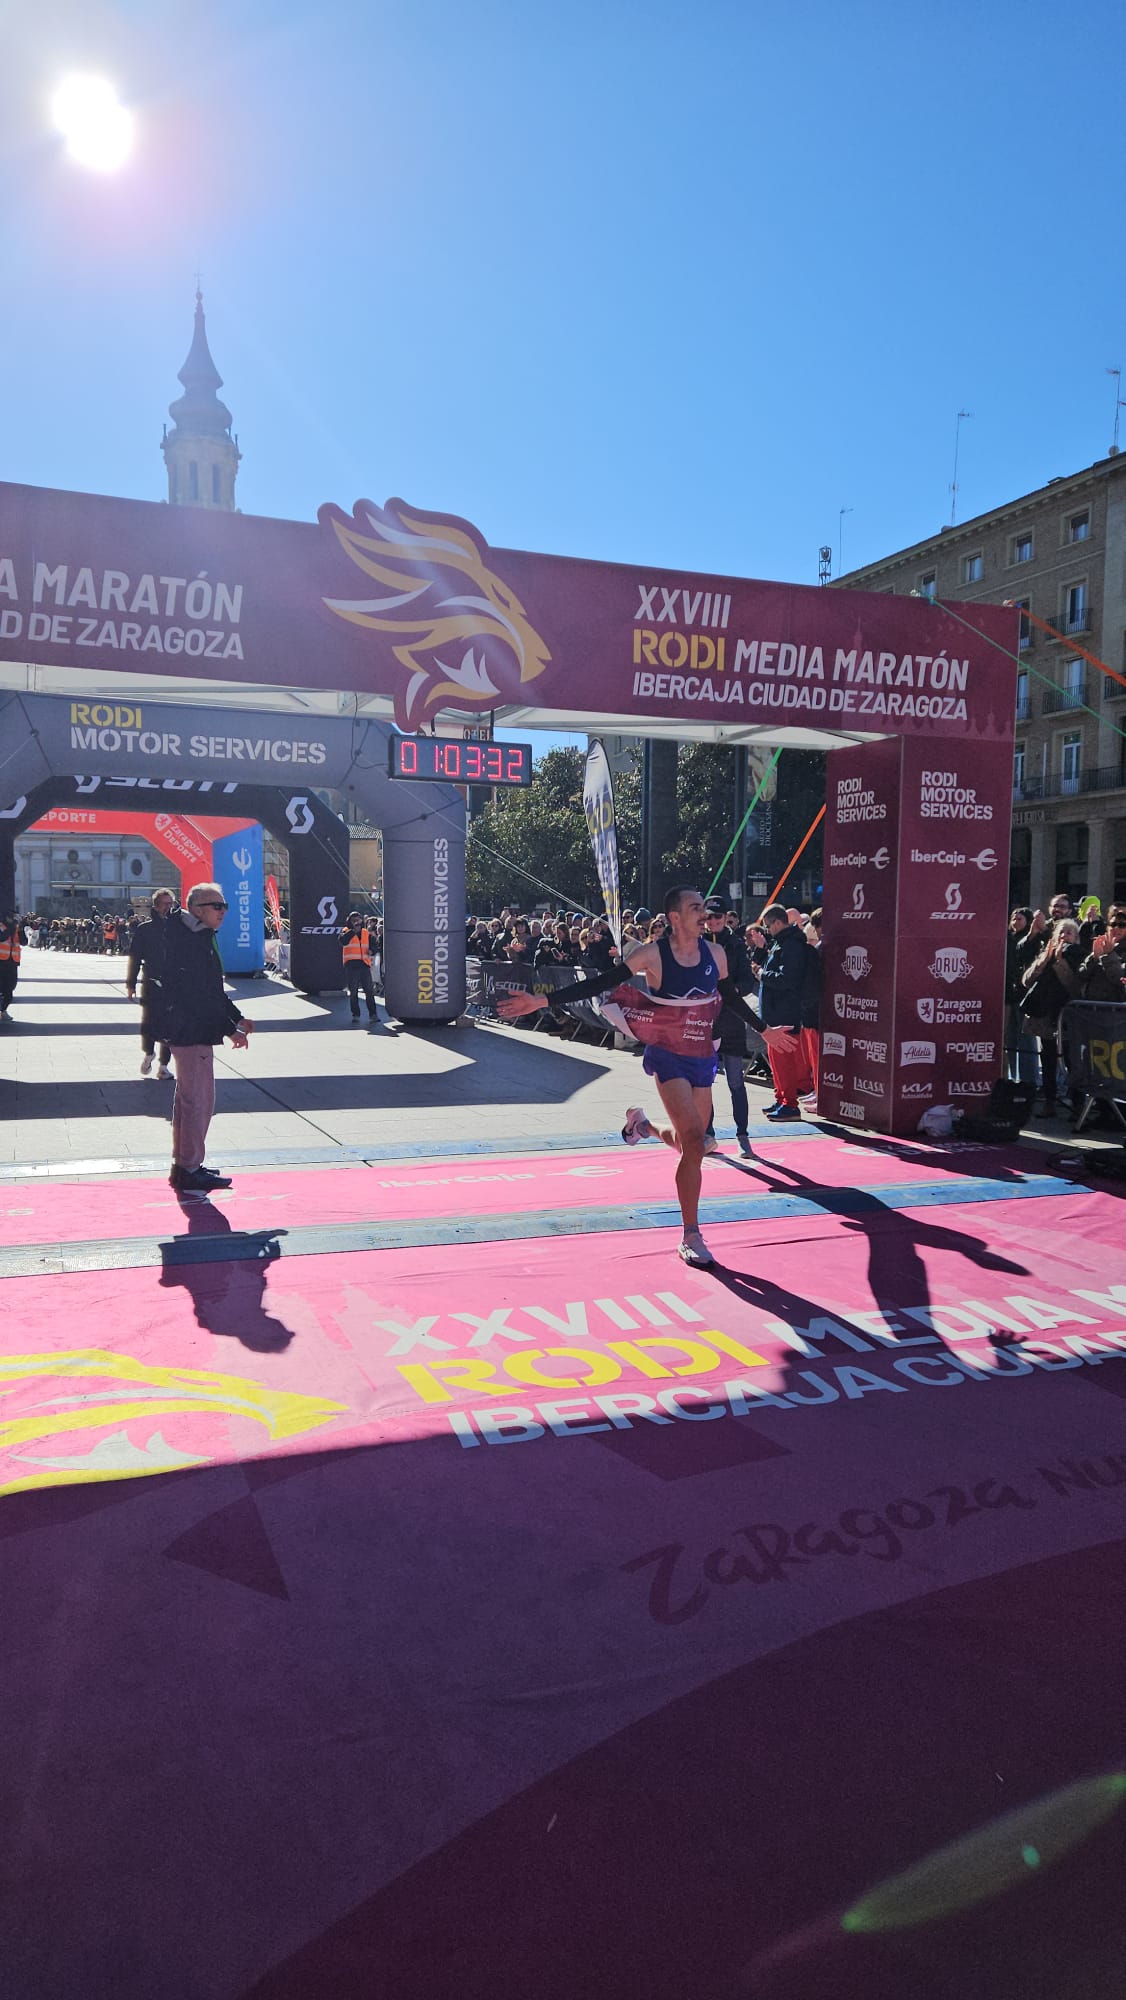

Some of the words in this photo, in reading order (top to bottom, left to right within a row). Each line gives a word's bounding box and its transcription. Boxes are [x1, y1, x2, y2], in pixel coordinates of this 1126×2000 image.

[33, 562, 243, 623] MARATÓN
[634, 585, 732, 629] XXVIII
[28, 612, 73, 644] DE
[75, 618, 244, 660] ZARAGOZA
[633, 628, 726, 672] RODI
[734, 639, 825, 680] MEDIA
[833, 649, 969, 691] MARATÓN
[632, 671, 744, 704] IBERCAJA
[750, 682, 827, 712] CIUDAD
[829, 688, 857, 714] DE
[859, 690, 968, 721] ZARAGOZA
[71, 703, 142, 729] RODI
[71, 727, 182, 756] MOTOR
[189, 735, 327, 764] SERVICES
[837, 777, 862, 794] RODI
[921, 771, 957, 787] RODI
[837, 790, 875, 809] MOTOR
[920, 787, 976, 804] MOTOR
[41, 811, 96, 823] EPORTE
[836, 804, 887, 823] SERVICES
[920, 802, 993, 820] SERVICES
[434, 838, 449, 930] SERVICES
[842, 911, 874, 919] SCOTT
[929, 911, 976, 920] SCOTT
[299, 926, 343, 935] SCOT
[434, 935, 449, 1004] MOTOR
[846, 955, 868, 971] ORUS
[935, 957, 966, 973] ORUS
[418, 959, 433, 1004] RODI
[847, 994, 878, 1010] Zaragoza
[936, 998, 982, 1012] Zaragoza
[936, 1011, 982, 1024] DEPORTE
[852, 1039, 888, 1053] POWER
[946, 1042, 995, 1053] POWER
[866, 1051, 887, 1063] ADE
[966, 1052, 993, 1062] ADE
[853, 1076, 884, 1094] LACASA
[948, 1081, 992, 1095] LACASA
[373, 1291, 706, 1356] XXVIII
[395, 1330, 773, 1404] RODI
[762, 1295, 1103, 1360] MEDIA
[447, 1365, 909, 1449] IBERCAJA
